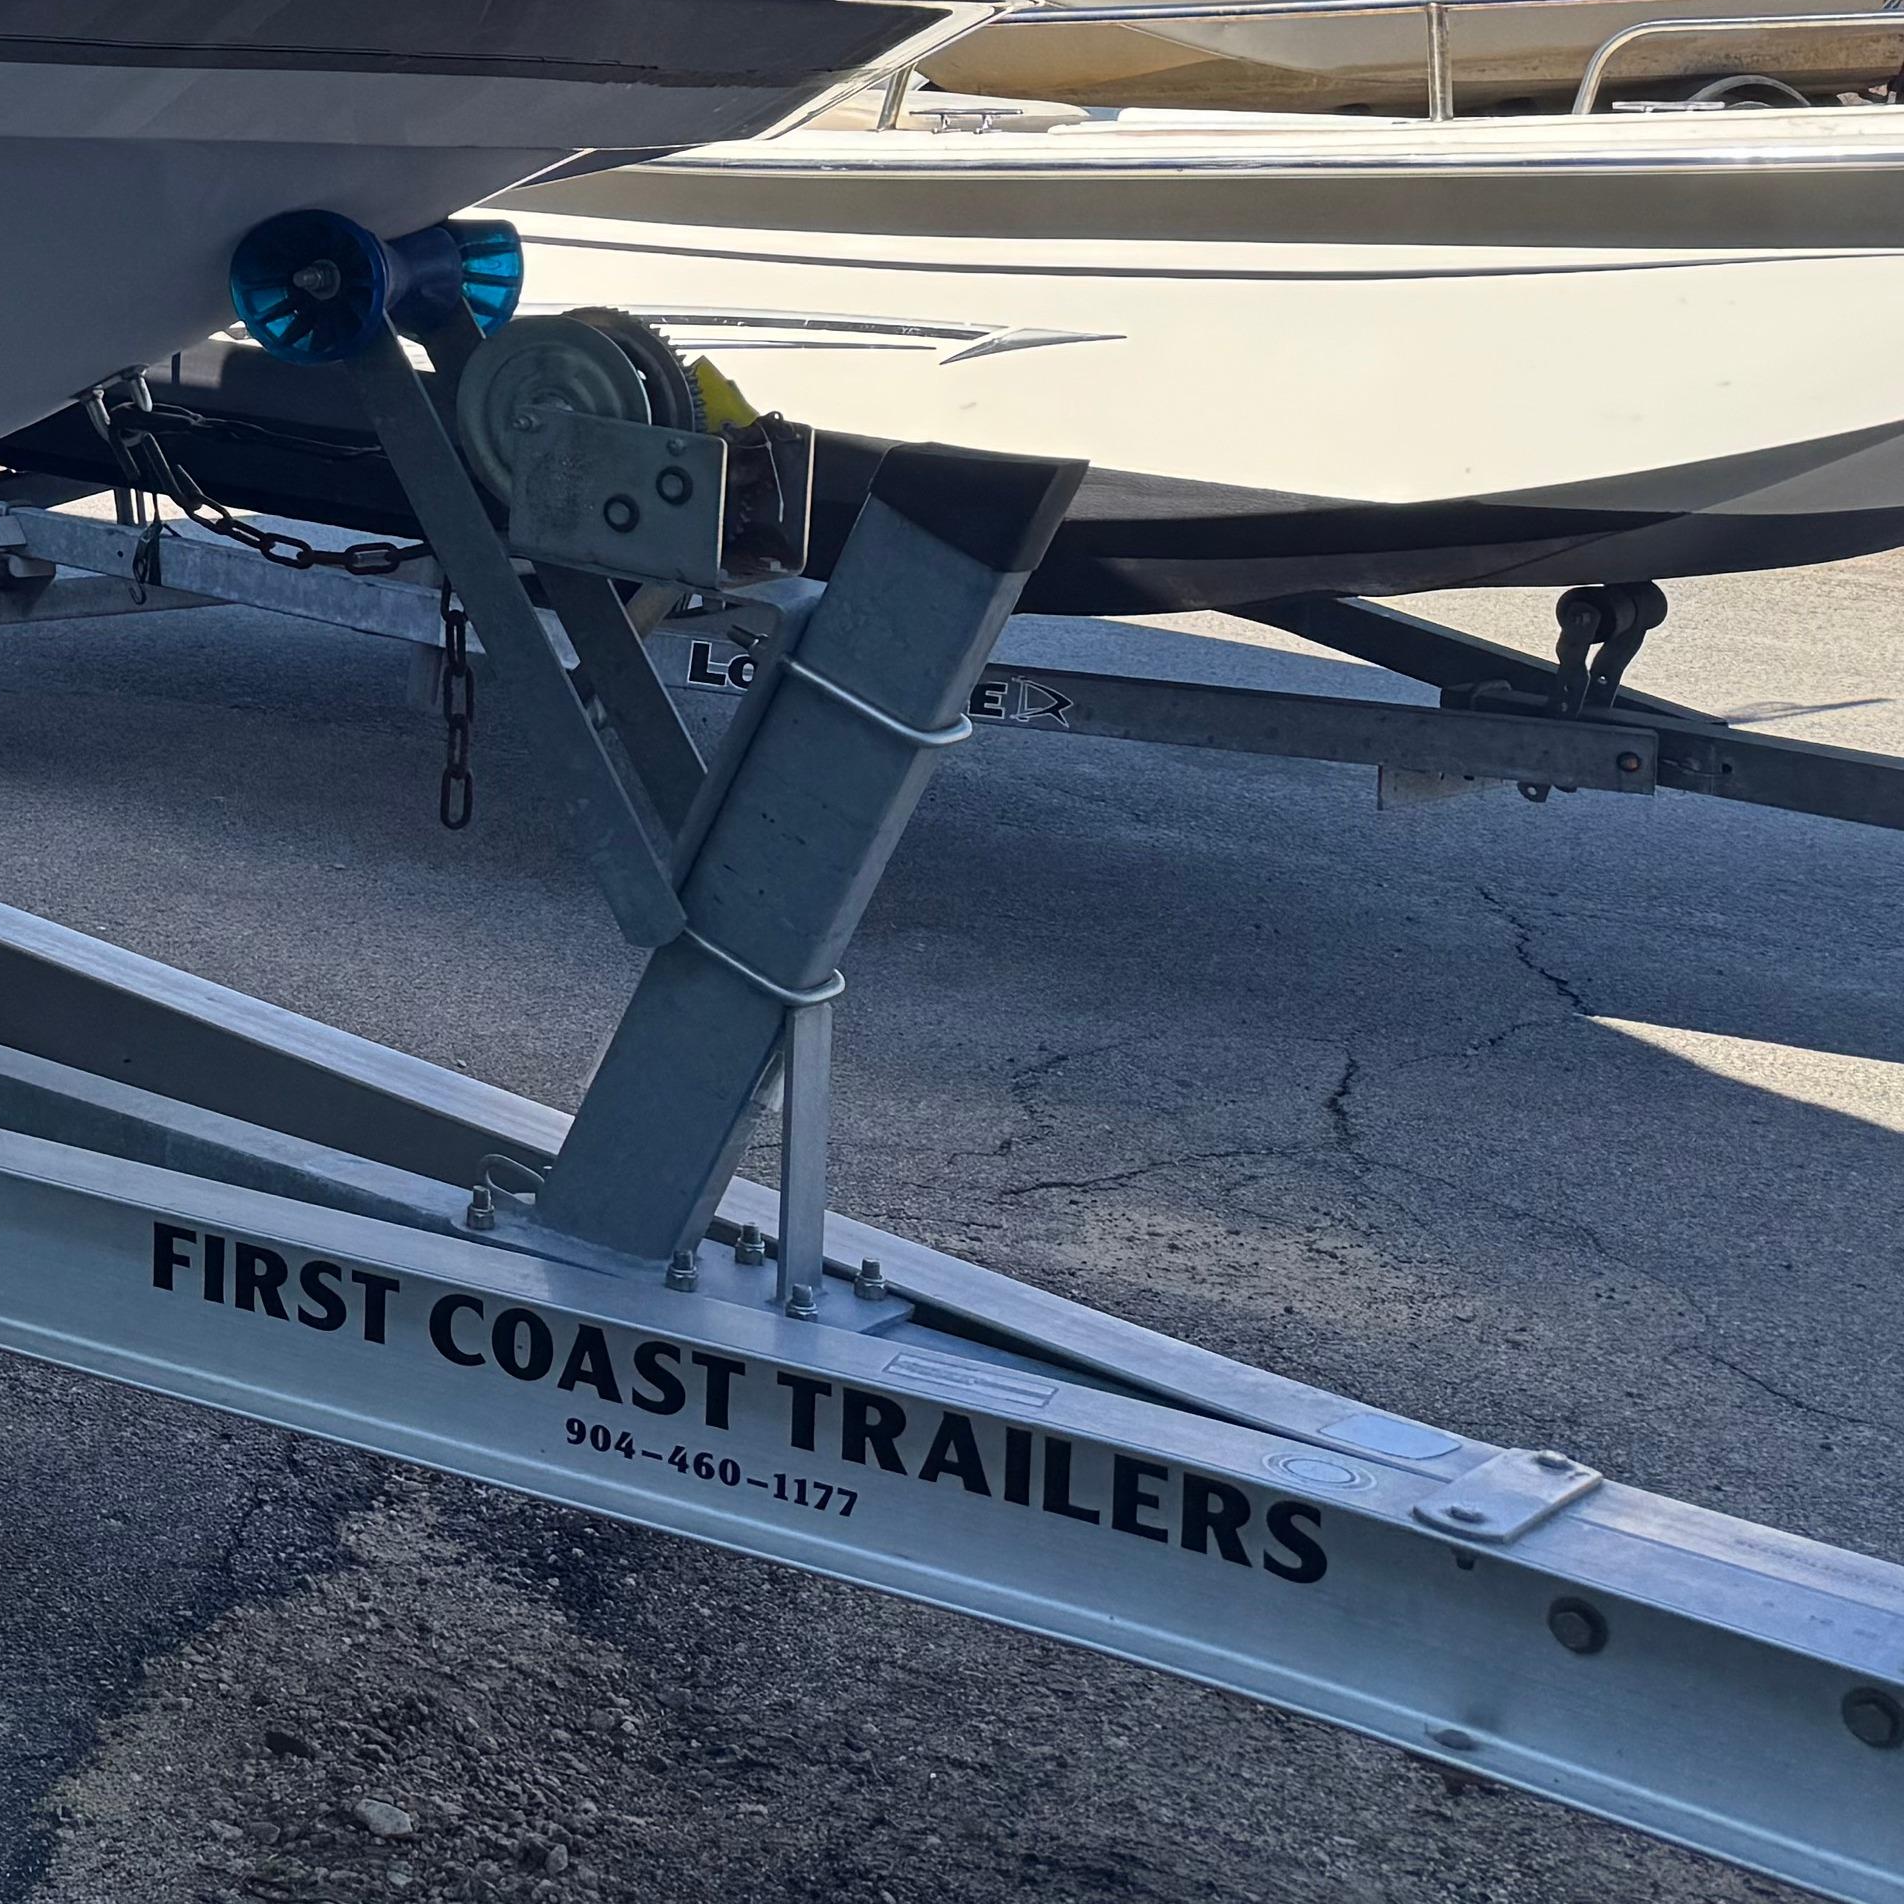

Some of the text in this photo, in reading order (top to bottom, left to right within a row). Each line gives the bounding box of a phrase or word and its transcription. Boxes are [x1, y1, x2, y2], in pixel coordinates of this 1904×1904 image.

[151, 1221, 1330, 1585] FIRST COAST TRAILERS
[565, 1417, 859, 1518] 904-460-1177
